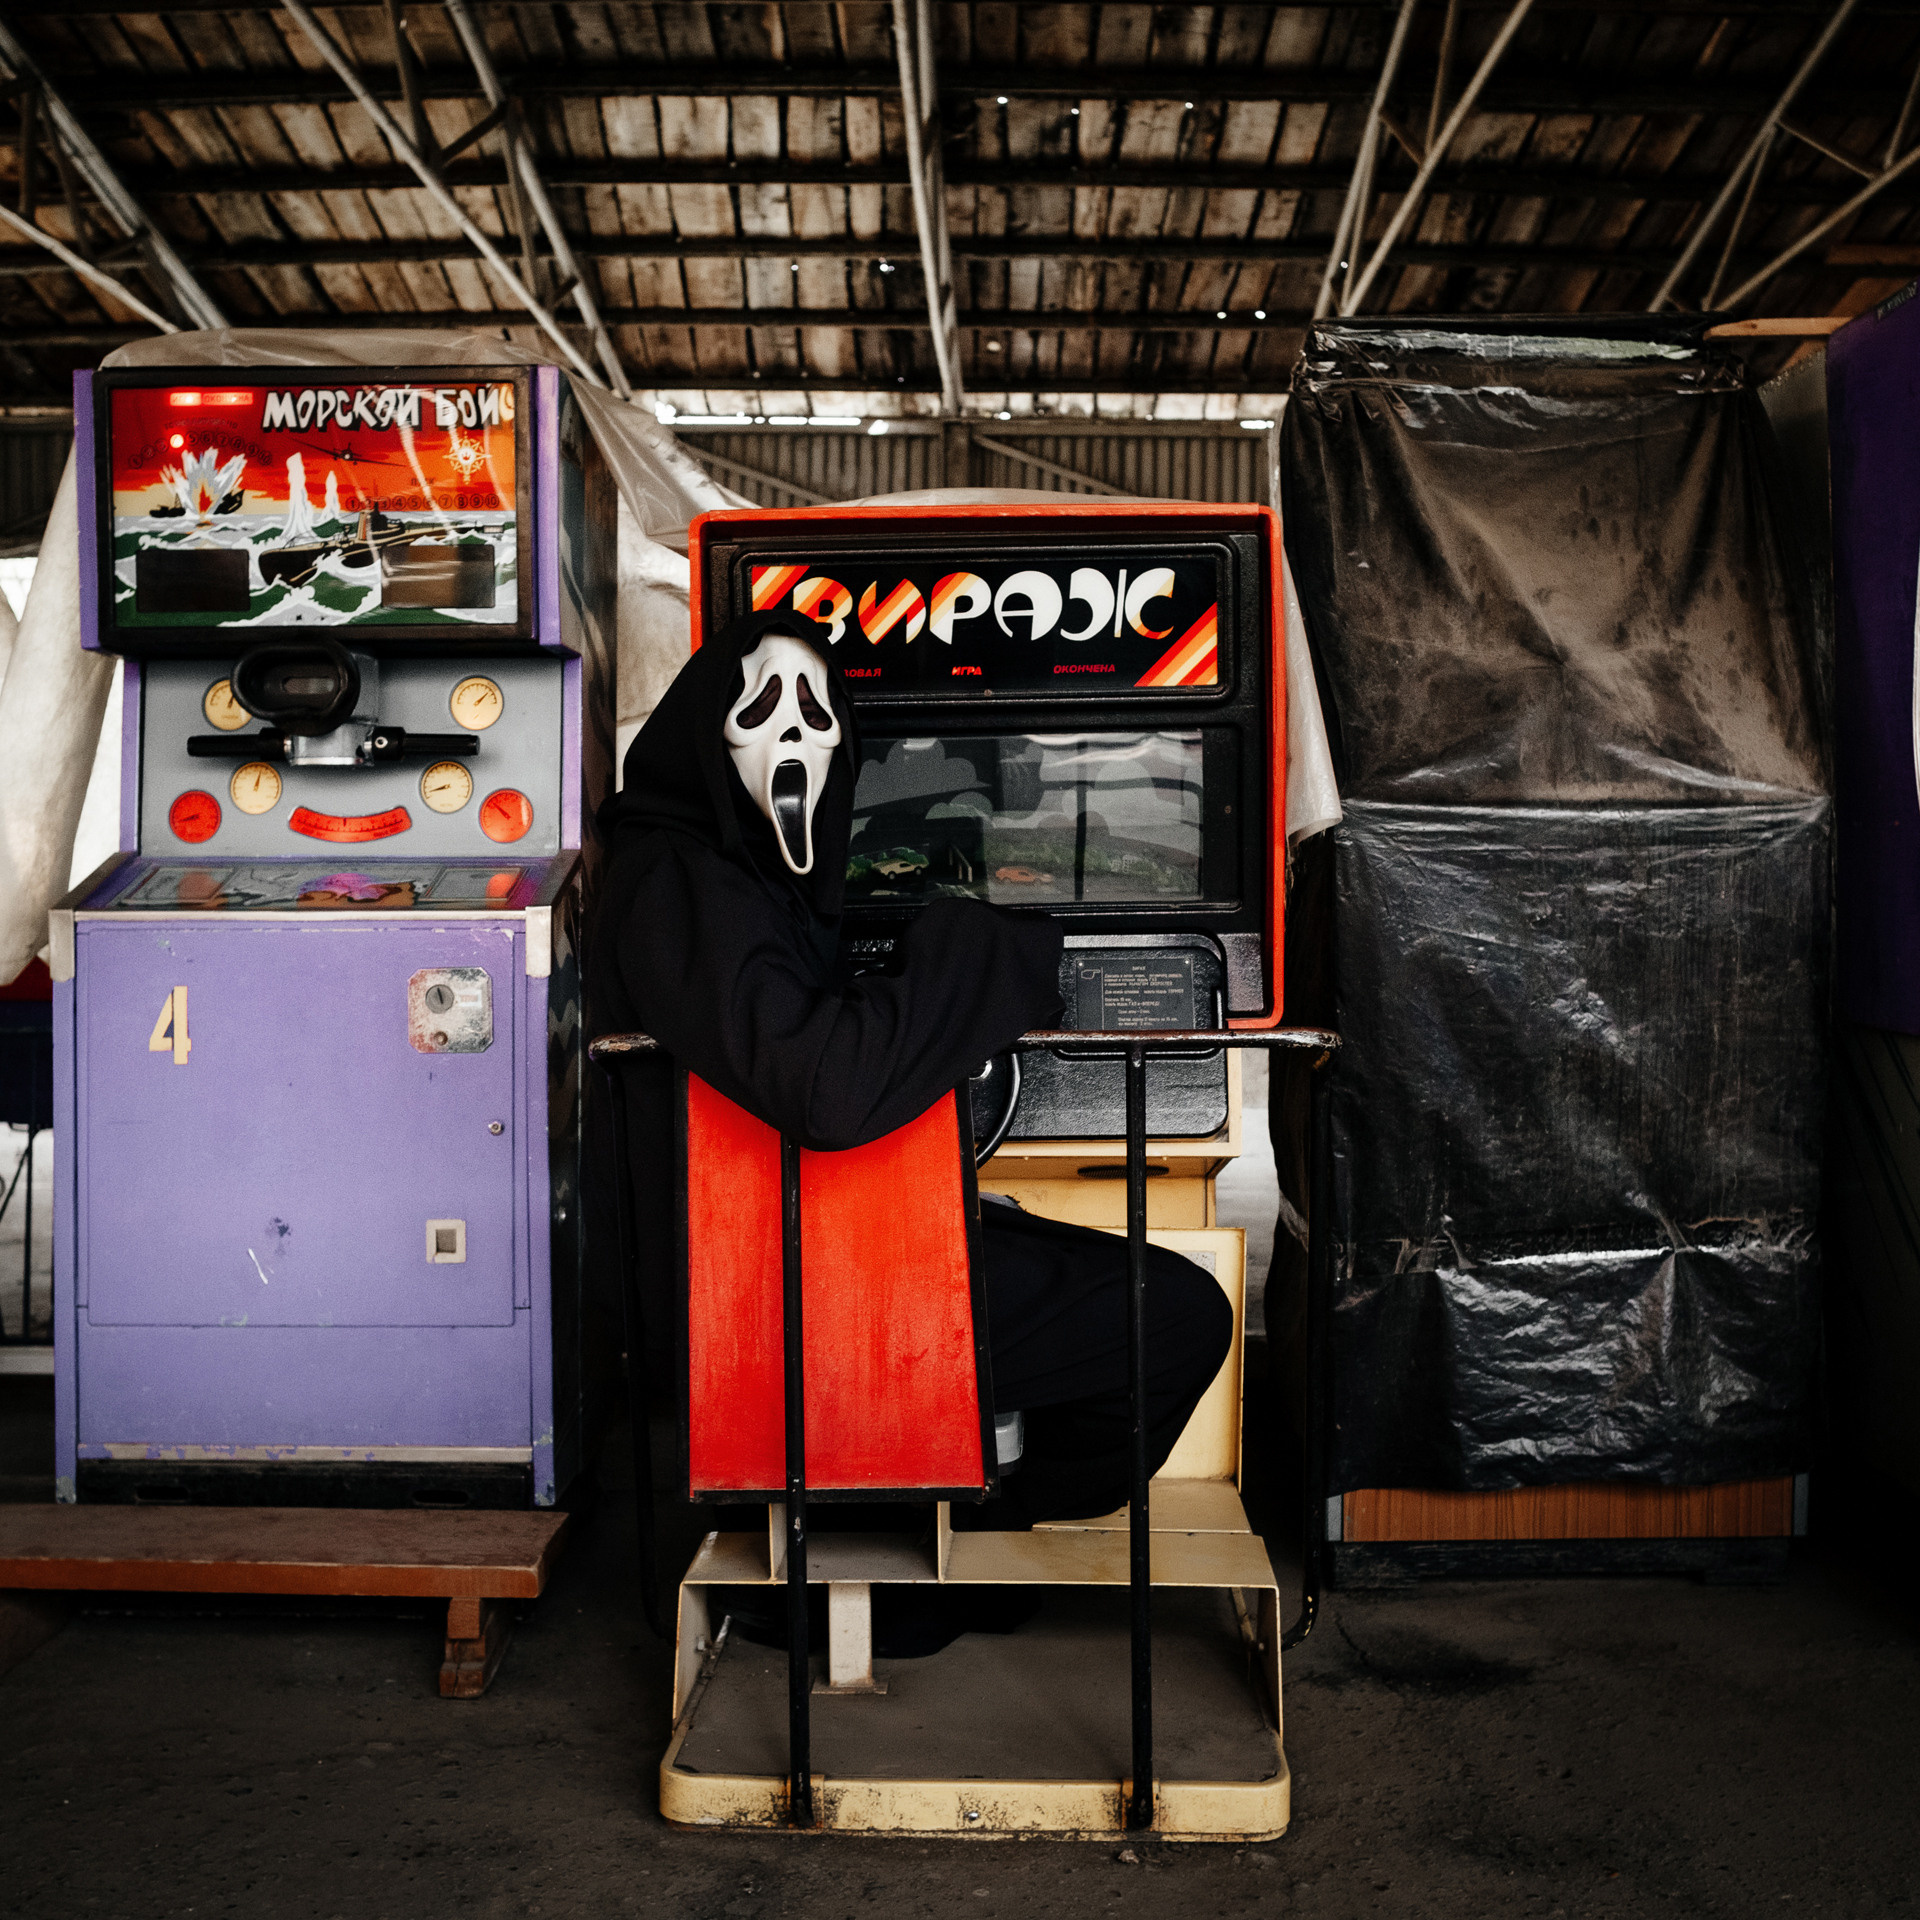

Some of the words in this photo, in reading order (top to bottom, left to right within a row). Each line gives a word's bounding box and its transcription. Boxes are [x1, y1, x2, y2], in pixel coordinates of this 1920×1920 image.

[262, 384, 420, 429] МОРСКОЙ
[434, 384, 500, 428] БОЙ
[793, 567, 1175, 645] ВИРАЖ
[951, 666, 983, 676] ИГРА
[1053, 664, 1116, 674] ОКОНЧЕНА
[149, 986, 192, 1065] 4
